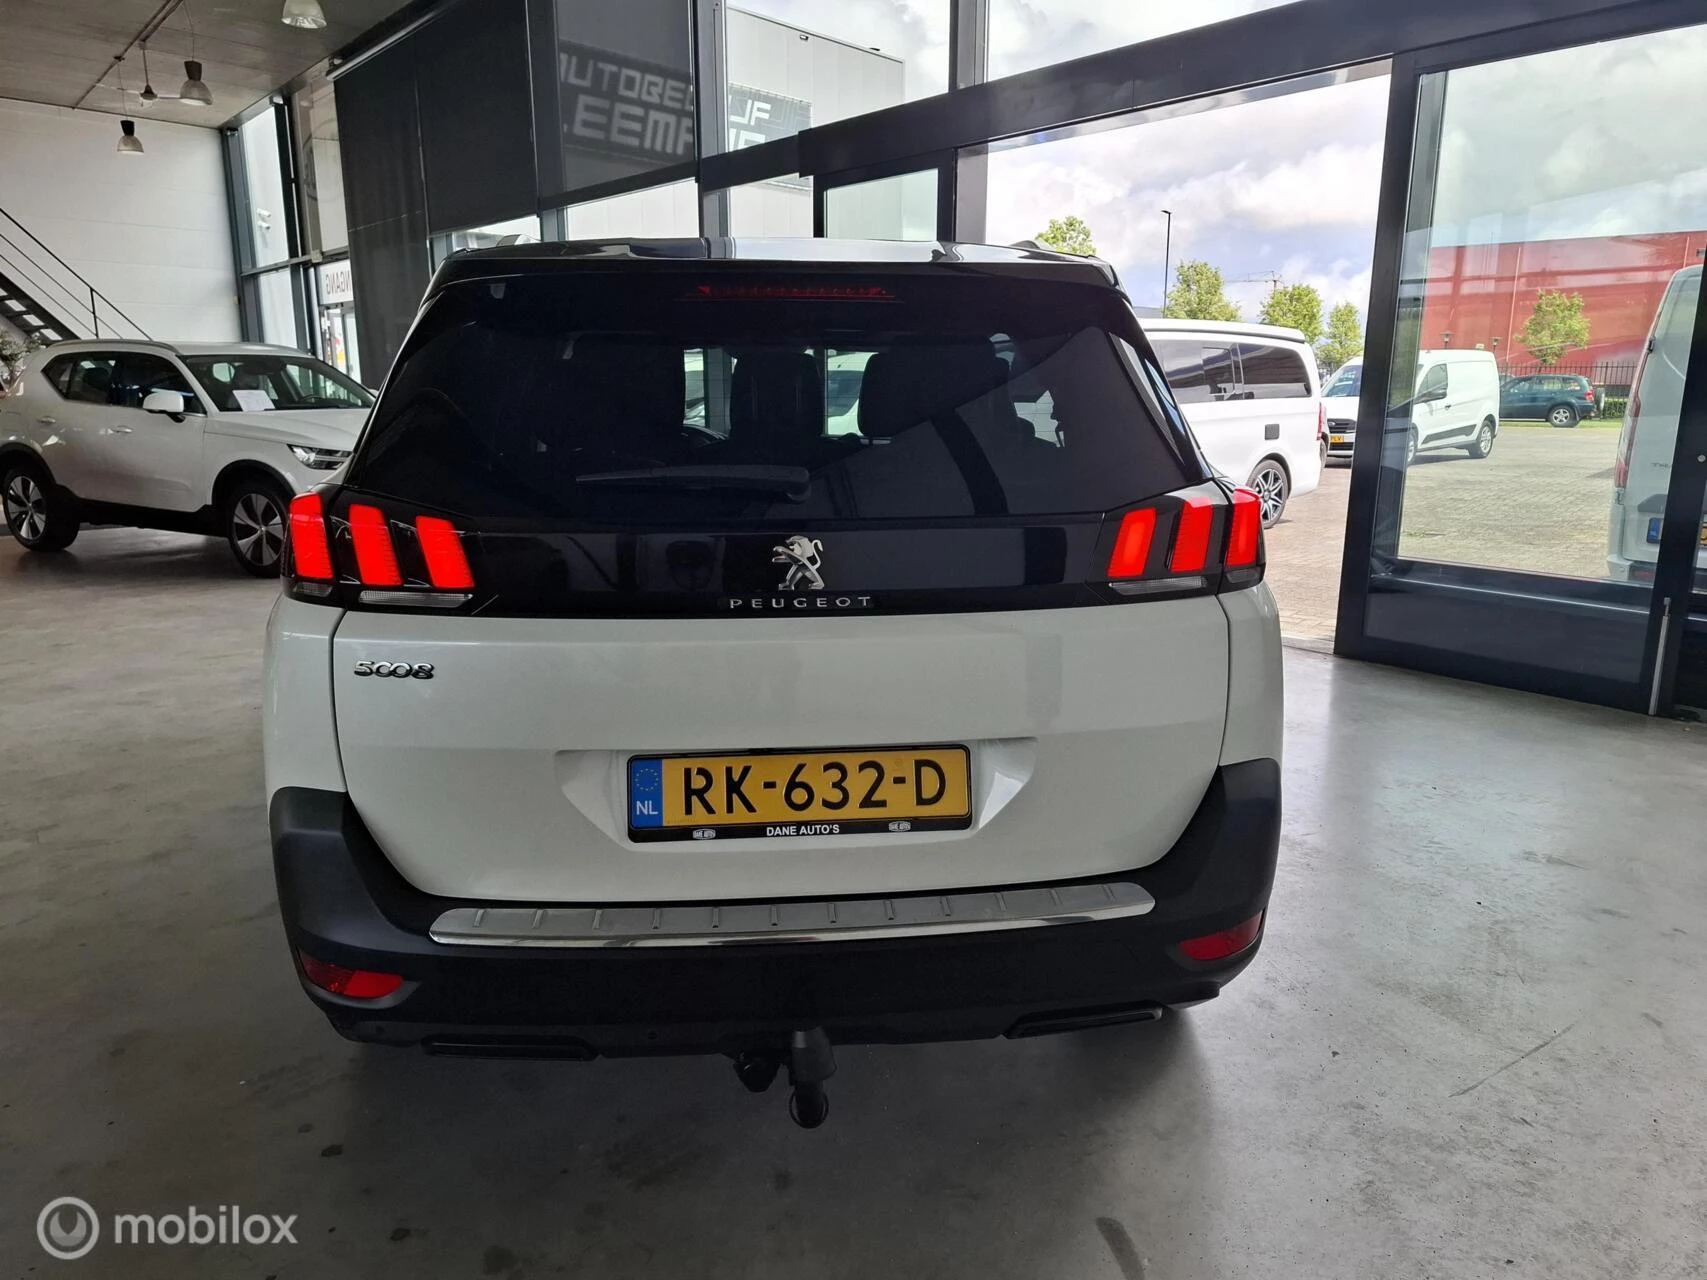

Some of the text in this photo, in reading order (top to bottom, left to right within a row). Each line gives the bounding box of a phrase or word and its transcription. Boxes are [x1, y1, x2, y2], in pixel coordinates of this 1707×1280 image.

[729, 596, 871, 609] PEUGEOT
[354, 660, 434, 680] 5008
[683, 758, 947, 816] RK-632-D
[635, 800, 659, 815] NL
[766, 824, 840, 837] DANE AUTO'S
